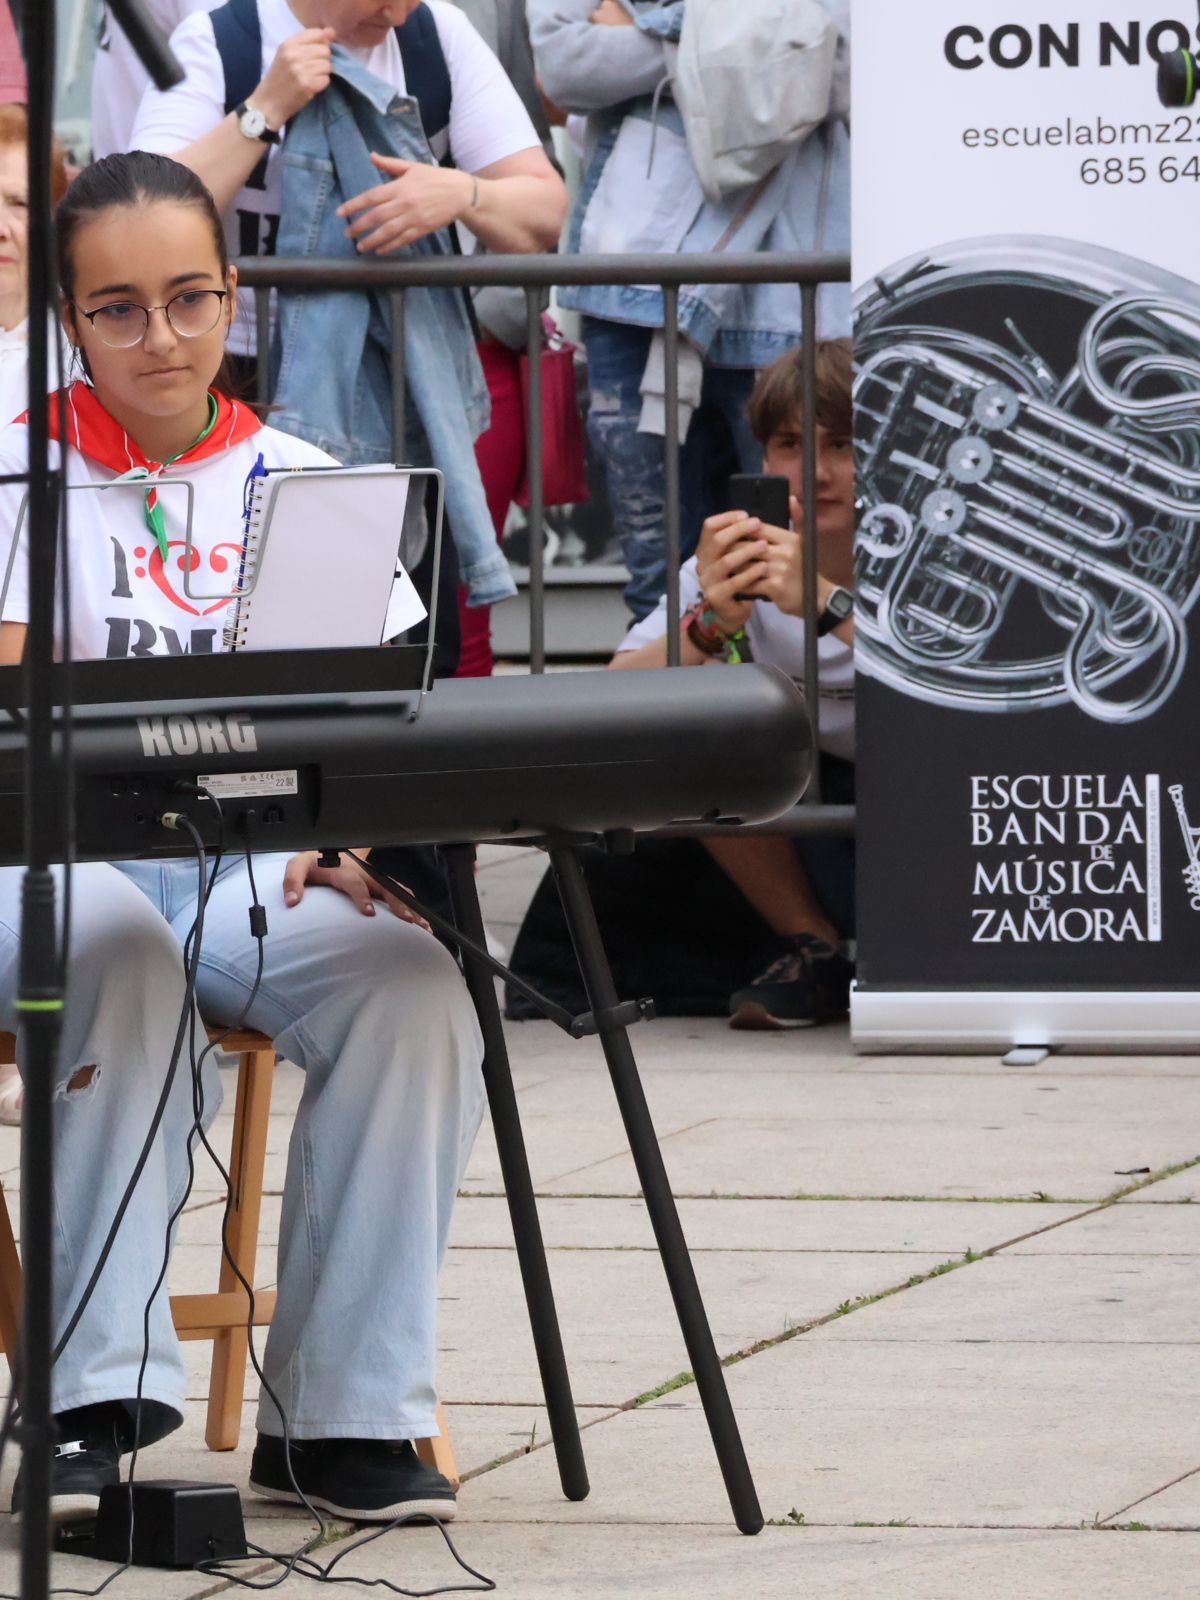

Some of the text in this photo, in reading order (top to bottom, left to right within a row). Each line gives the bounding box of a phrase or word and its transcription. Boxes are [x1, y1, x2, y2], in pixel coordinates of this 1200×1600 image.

[944, 20, 1200, 69] CON NO
[962, 116, 1200, 147] escuelabmz2
[1080, 156, 1200, 184] 685 64
[137, 713, 257, 757] KORG
[970, 775, 1144, 809] ESCUELA
[970, 811, 1145, 845] BANDA
[1090, 845, 1113, 860] DE
[972, 854, 1145, 895] MÚSICA
[1029, 895, 1051, 910] DE
[971, 908, 1147, 942] ZAMORA
